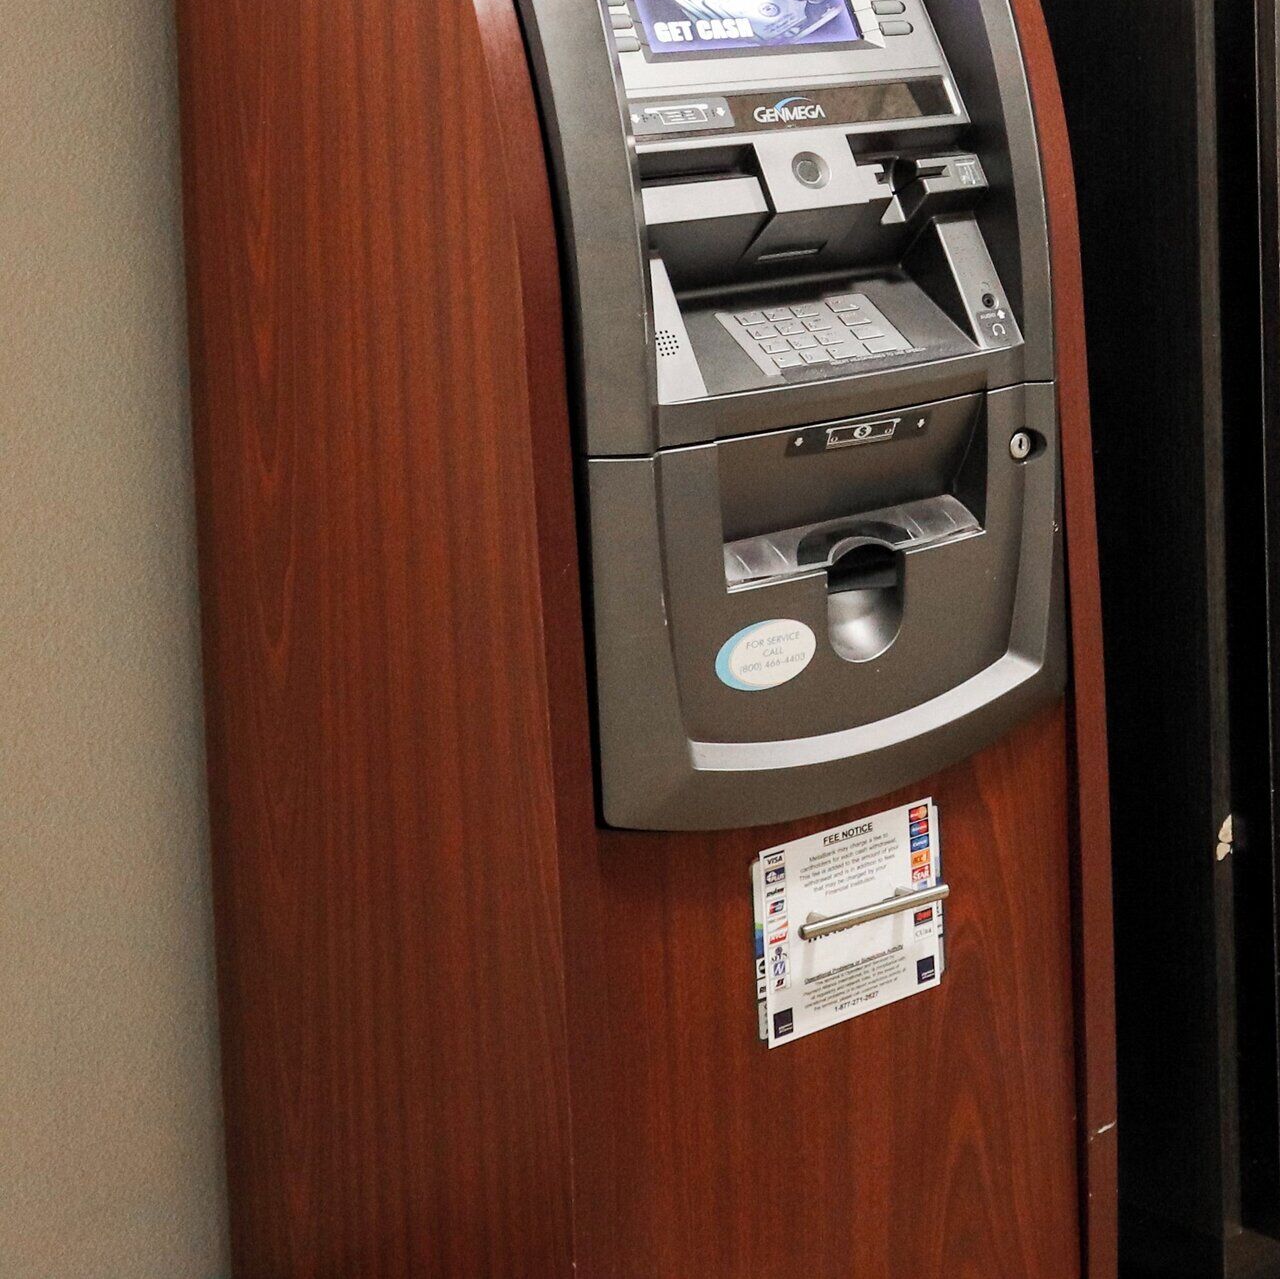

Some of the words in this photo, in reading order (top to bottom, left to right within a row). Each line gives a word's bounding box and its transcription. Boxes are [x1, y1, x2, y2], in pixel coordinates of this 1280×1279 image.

[653, 20, 695, 43] GET
[699, 17, 754, 41] CASH
[753, 104, 826, 124] GENMEGA
[745, 638, 765, 650] FOR
[766, 631, 801, 646] SERVICE
[762, 647, 783, 658] CALL
[740, 662, 763, 674] (800)
[822, 831, 840, 846] FEE
[841, 821, 874, 840] NOTICE
[767, 855, 783, 865] VISA
[912, 869, 930, 881] STAR
